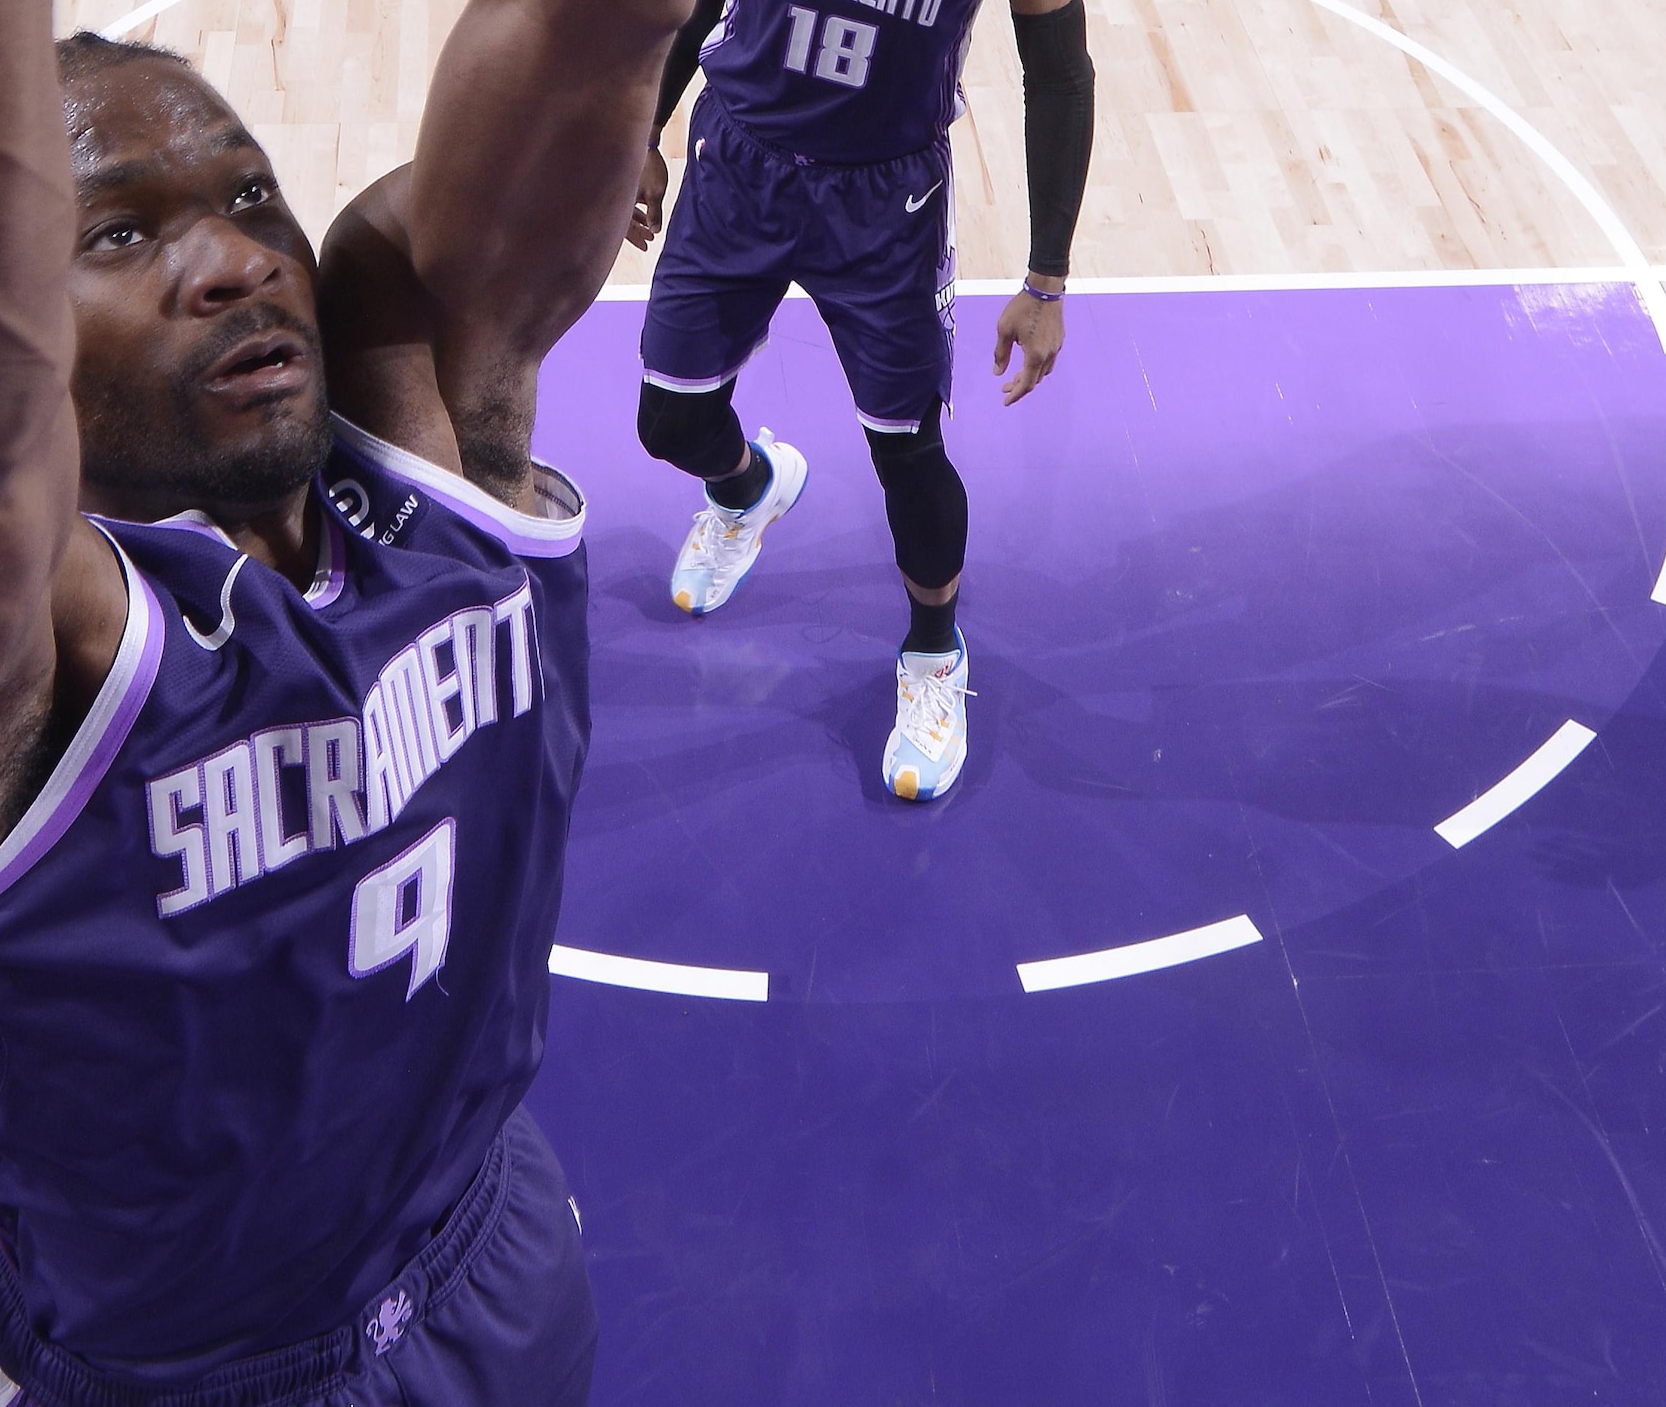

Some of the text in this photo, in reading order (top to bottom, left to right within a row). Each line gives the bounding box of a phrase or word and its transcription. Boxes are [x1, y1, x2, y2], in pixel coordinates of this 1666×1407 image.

[784, 3, 880, 89] 18
[389, 494, 419, 533] LAW
[145, 569, 544, 919] SACRAMENT
[347, 816, 457, 1003] 9
